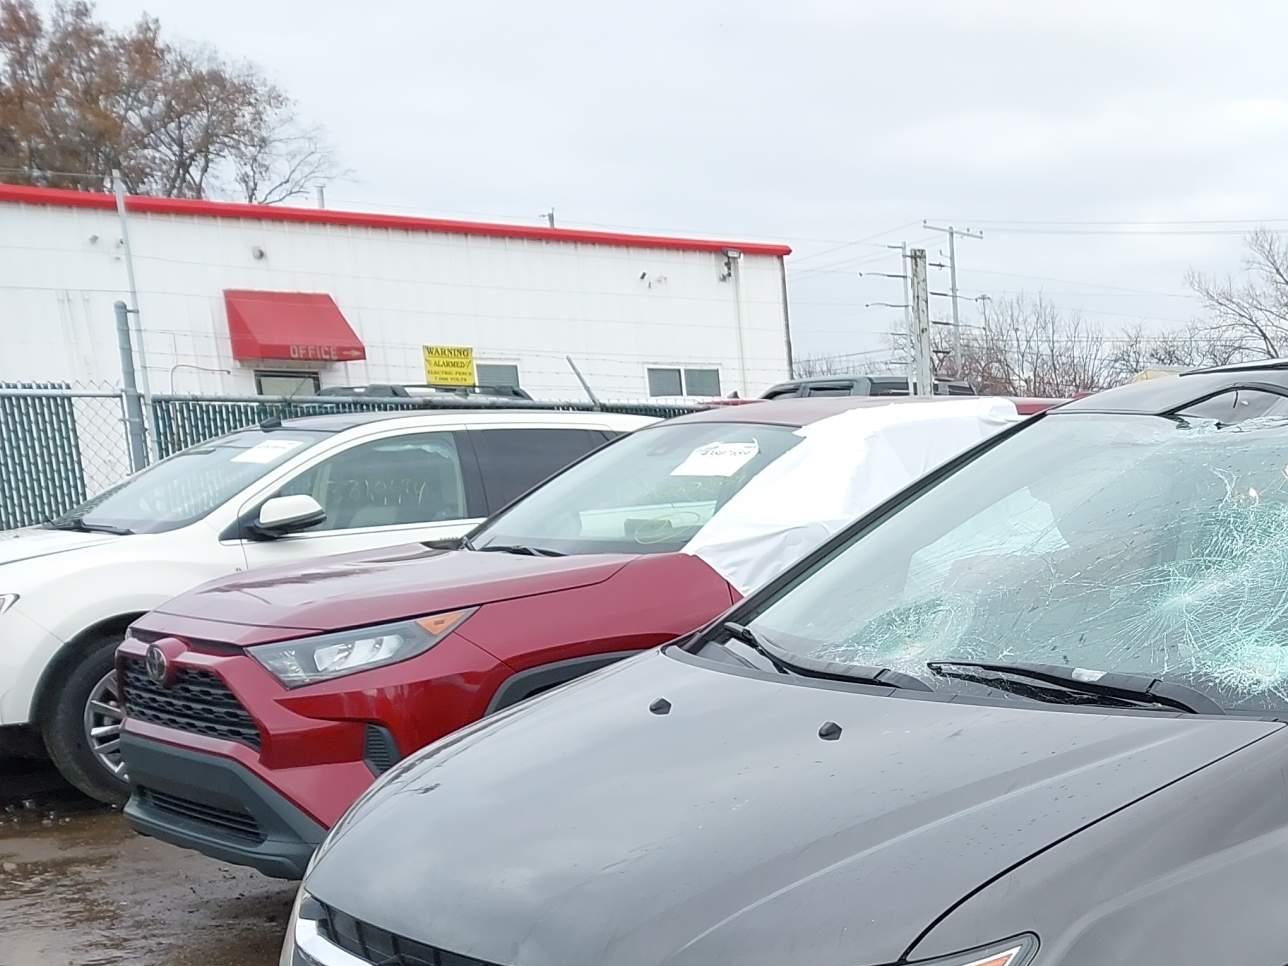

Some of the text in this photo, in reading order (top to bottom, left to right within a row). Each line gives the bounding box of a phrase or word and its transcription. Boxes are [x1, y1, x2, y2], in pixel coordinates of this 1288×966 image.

[289, 345, 338, 360] OFFICE
[426, 346, 470, 358] WARNING
[433, 360, 466, 369] ALARMED
